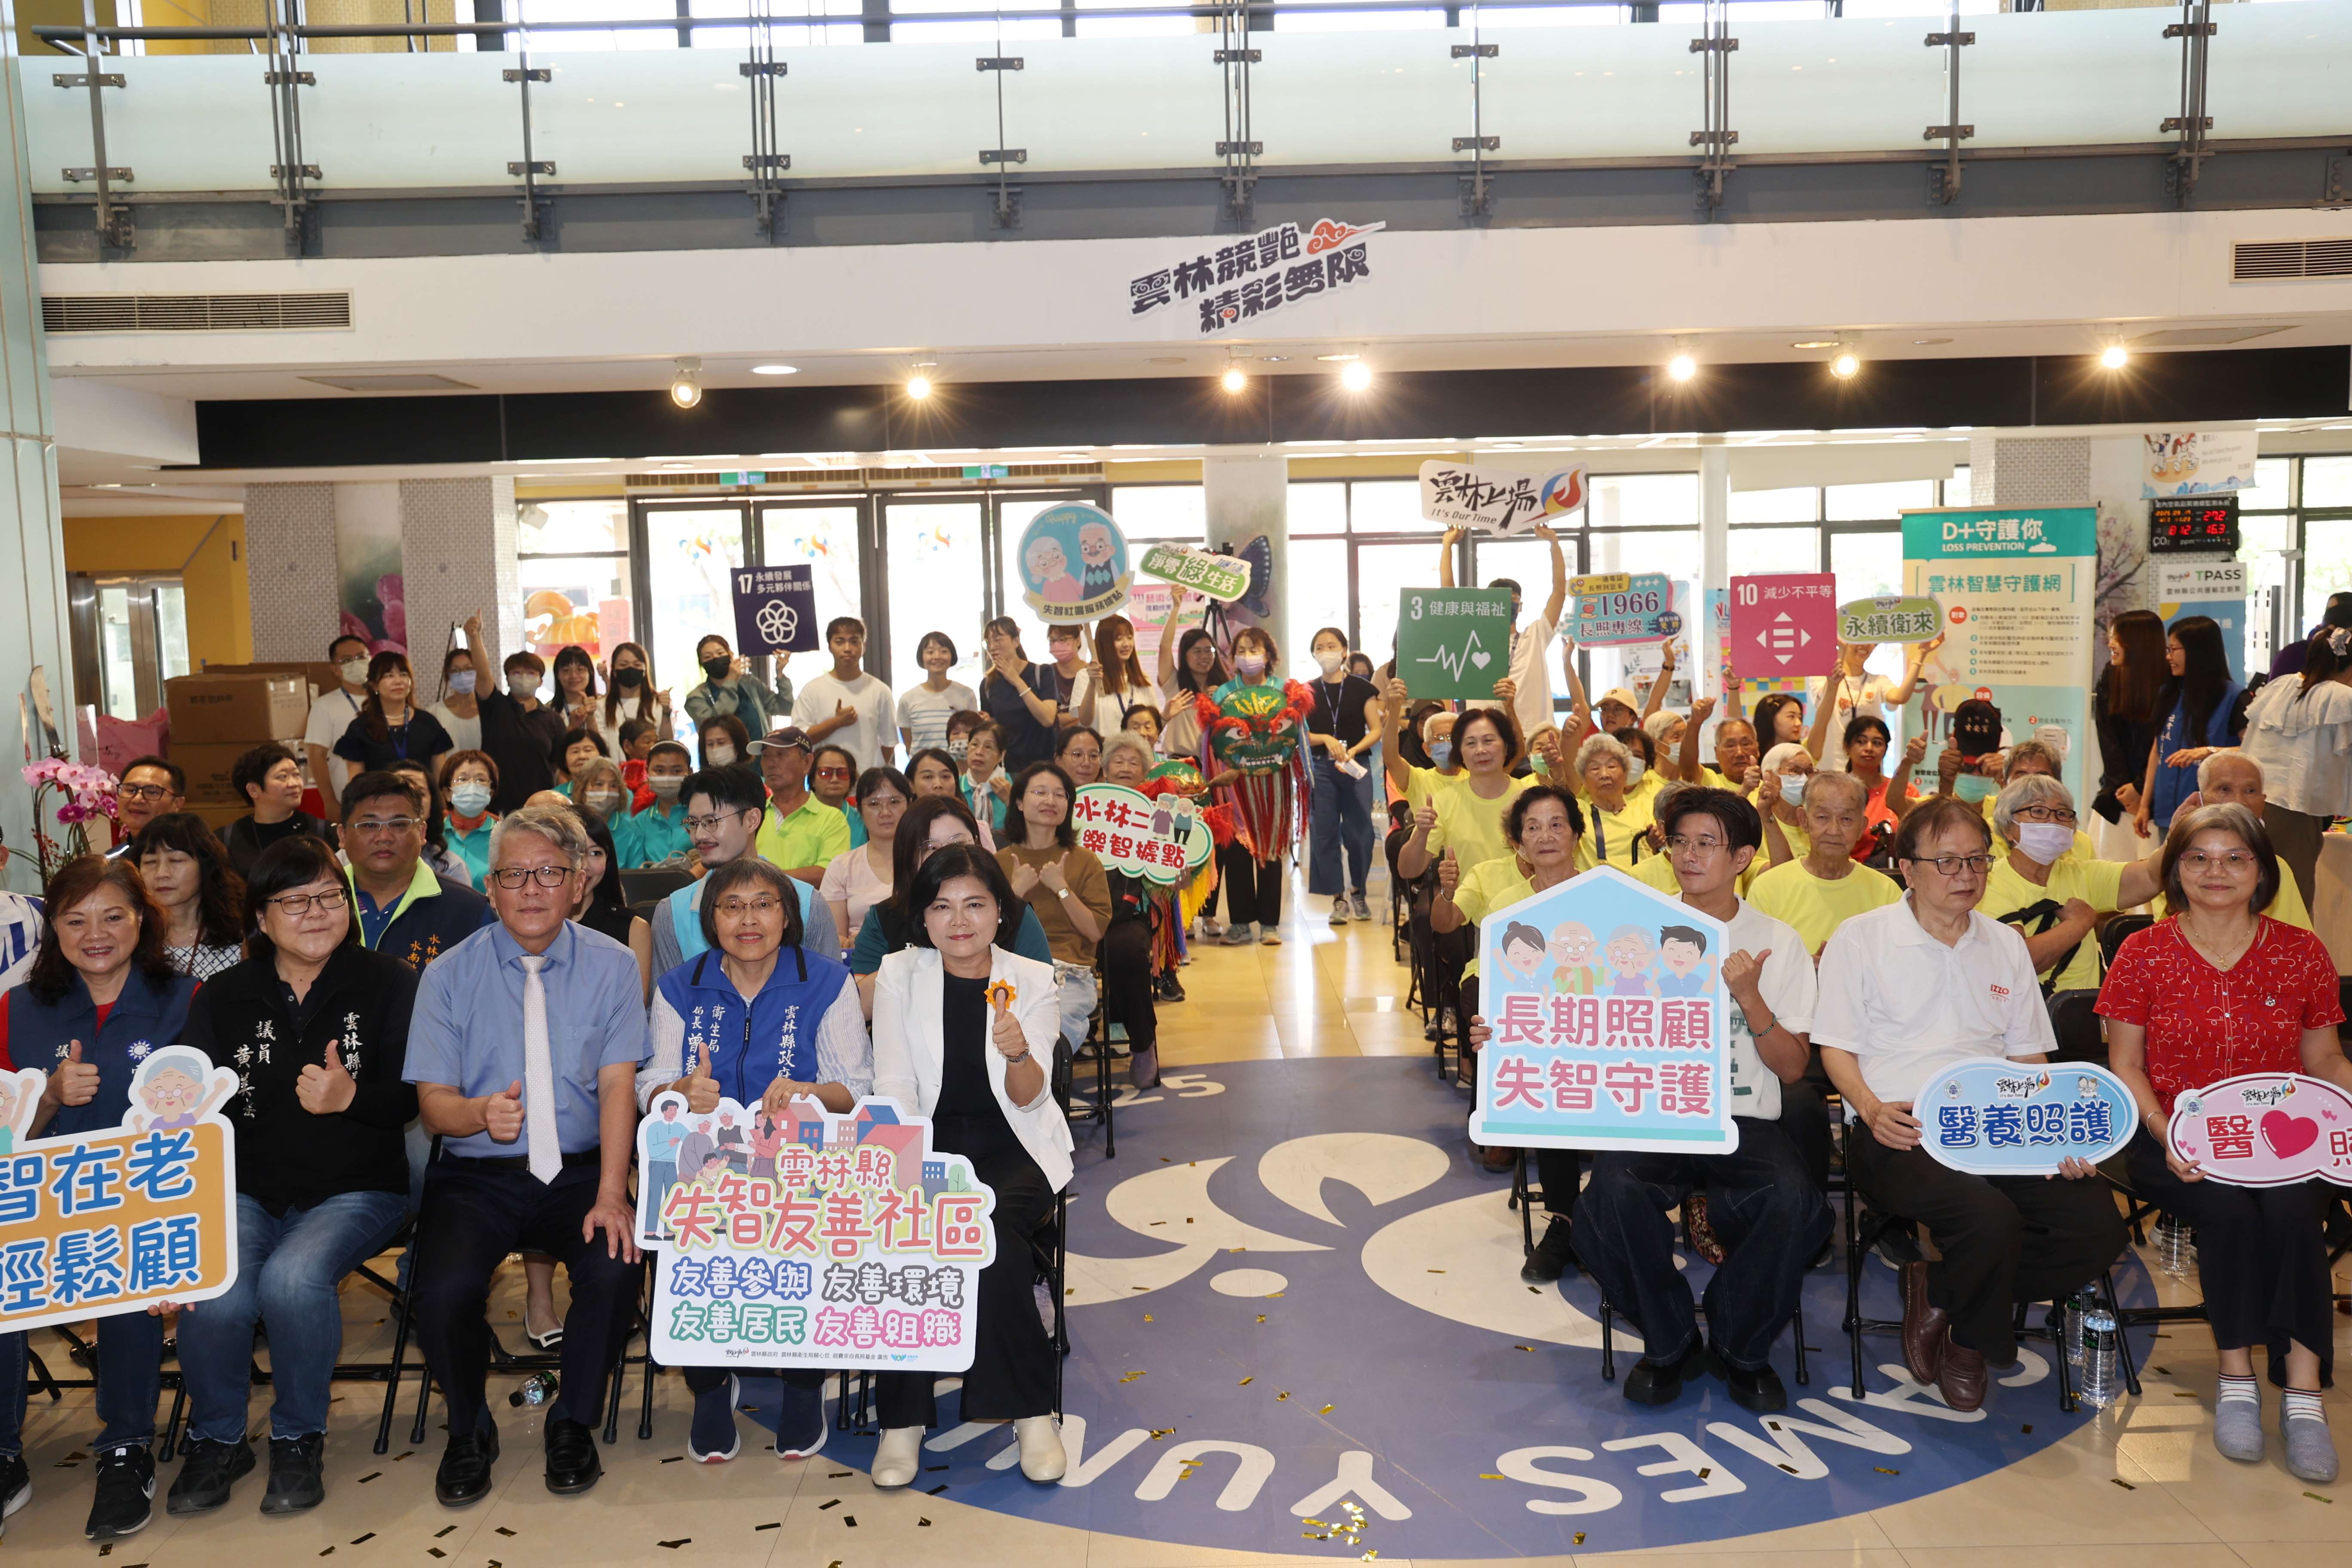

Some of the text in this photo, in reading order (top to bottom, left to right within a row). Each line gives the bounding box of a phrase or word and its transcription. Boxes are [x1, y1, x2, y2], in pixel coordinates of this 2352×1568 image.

[1200, 242, 1370, 334] 精彩無限
[1429, 470, 1537, 531] 雲林上場
[1431, 508, 1449, 517] It's
[1472, 514, 1497, 524] Time
[1942, 542, 2025, 551] LOSS PREVENTION
[738, 574, 753, 594] 17
[756, 570, 792, 582] 永續發展
[756, 581, 811, 594] 多元夥伴關係
[1148, 553, 1238, 593] 淨零綠生活
[1928, 574, 2062, 592] 雲林智慧守護網
[2195, 570, 2242, 581] TPASS
[1043, 590, 1123, 616] 失智社區服務據點
[1411, 596, 1422, 620] 3
[1430, 600, 1506, 616] 健康與福祉
[1602, 591, 1659, 616] 1966
[1737, 583, 1758, 606] 10
[1764, 585, 1833, 600] 減少不平等
[1580, 619, 1643, 637] 長照專線
[1846, 611, 1934, 638] 永續衛來
[1075, 795, 1150, 829] 水林二
[1991, 984, 2009, 995] IZZO
[707, 1004, 726, 1053] 衛生局
[1497, 995, 1711, 1049] 長期照顧
[255, 1020, 276, 1064] 議員
[343, 1012, 363, 1079] 雲林縣
[1496, 1058, 1710, 1115] 失智守護
[1939, 1099, 2112, 1147] 醫養照護
[2206, 1115, 2254, 1160] 醫
[780, 1148, 891, 1189] 雲林縣
[663, 1175, 983, 1257] 失智友善社區
[673, 1258, 810, 1298] 友善參與
[825, 1264, 963, 1308] 友善環境
[672, 1304, 805, 1343] 友善居民
[817, 1308, 959, 1345] 友善組織
